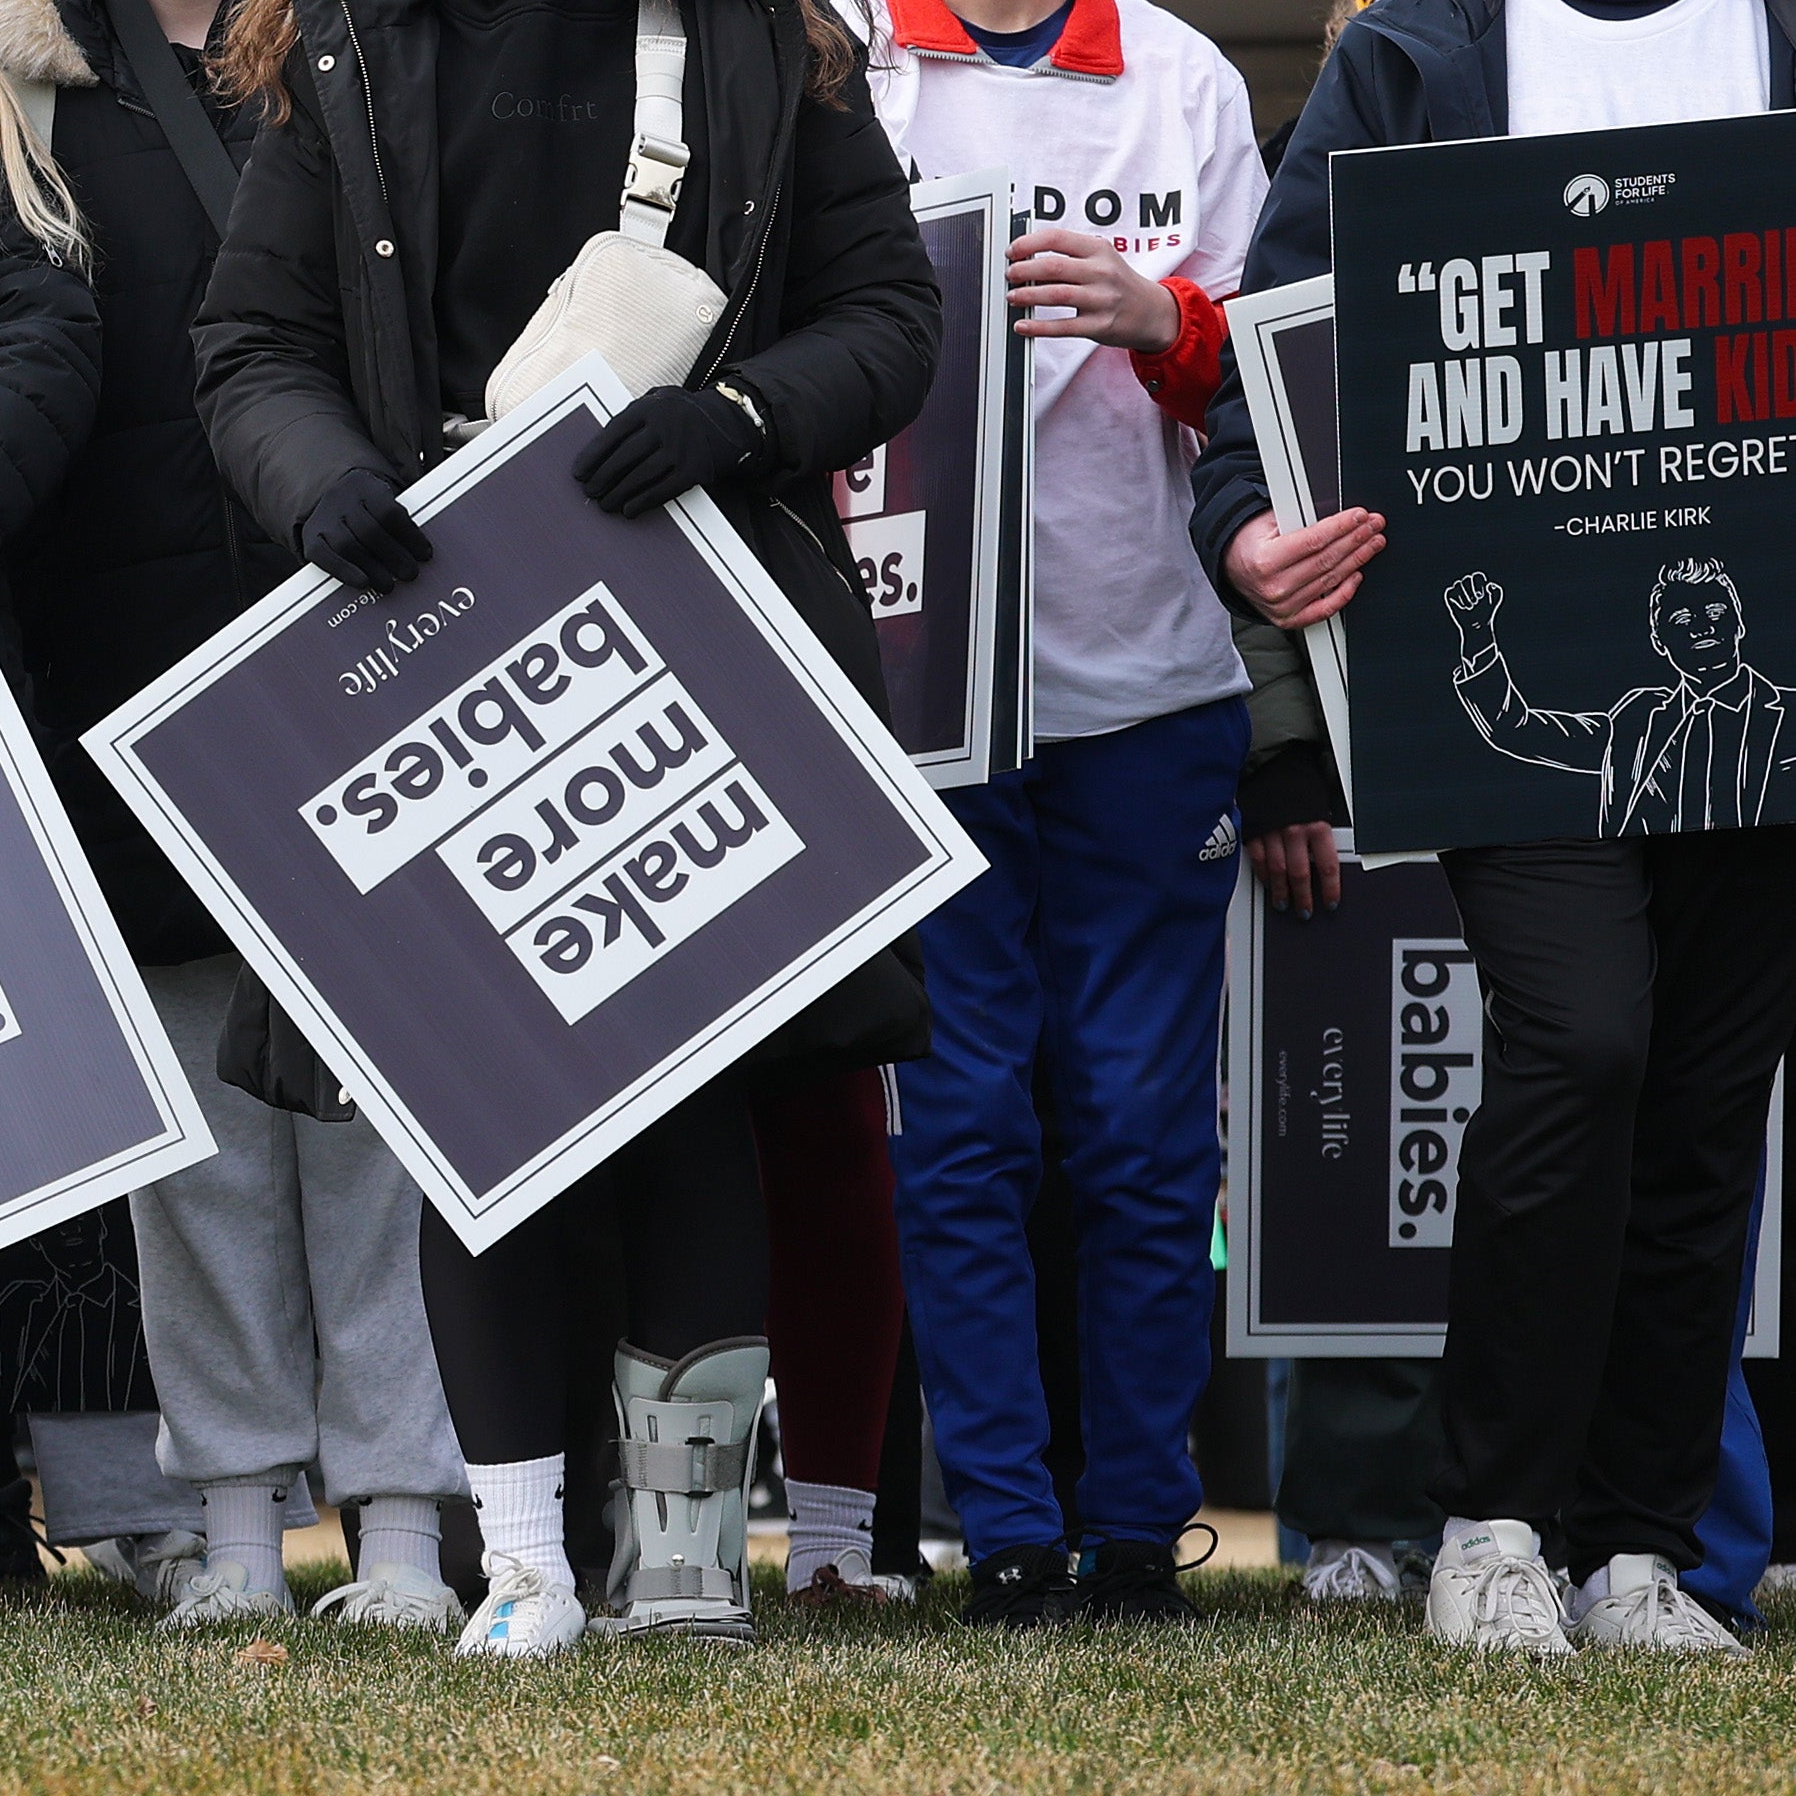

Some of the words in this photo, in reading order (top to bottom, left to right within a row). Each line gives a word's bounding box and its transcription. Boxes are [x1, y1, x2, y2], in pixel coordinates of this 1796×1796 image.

[489, 90, 598, 122] Comfrt
[1614, 173, 1676, 189] STUDENTS
[1615, 187, 1640, 200] FOR
[1112, 233, 1181, 254] BIES
[1397, 250, 1551, 353] “GET
[1572, 230, 1796, 341] MARRI
[1406, 354, 1524, 453] AND
[1546, 338, 1695, 442] HAVE
[1714, 329, 1796, 424] KID
[1406, 460, 1493, 506] YOU
[1508, 448, 1642, 499] WON’T
[1659, 434, 1796, 484] REGRE
[1553, 508, 1660, 537] -CHARLIE
[1664, 506, 1712, 530] KIRK
[338, 586, 476, 697] everylife
[314, 605, 651, 837] babies.
[475, 699, 711, 893] more
[537, 795, 772, 977] make
[1311, 1026, 1351, 1160] everylife
[1398, 948, 1476, 1241] babies.
[1461, 1535, 1491, 1551] adidas
